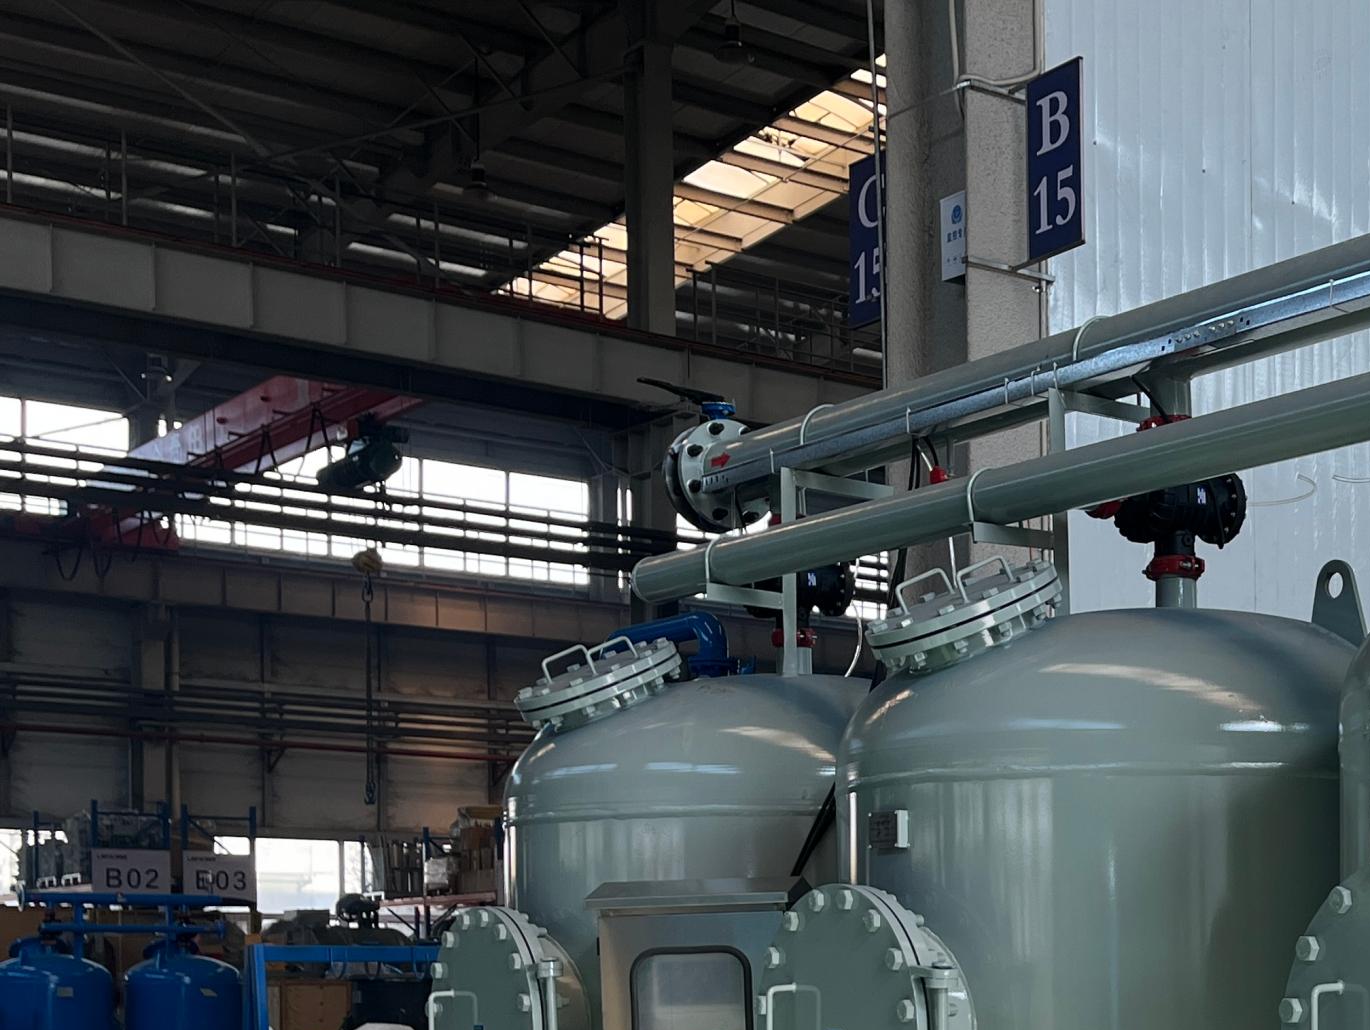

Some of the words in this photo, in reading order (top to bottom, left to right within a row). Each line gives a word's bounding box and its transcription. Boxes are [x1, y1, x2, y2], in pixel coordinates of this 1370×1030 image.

[1036, 91, 1070, 156] B
[1033, 164, 1076, 235] 15
[105, 867, 160, 890] B02
